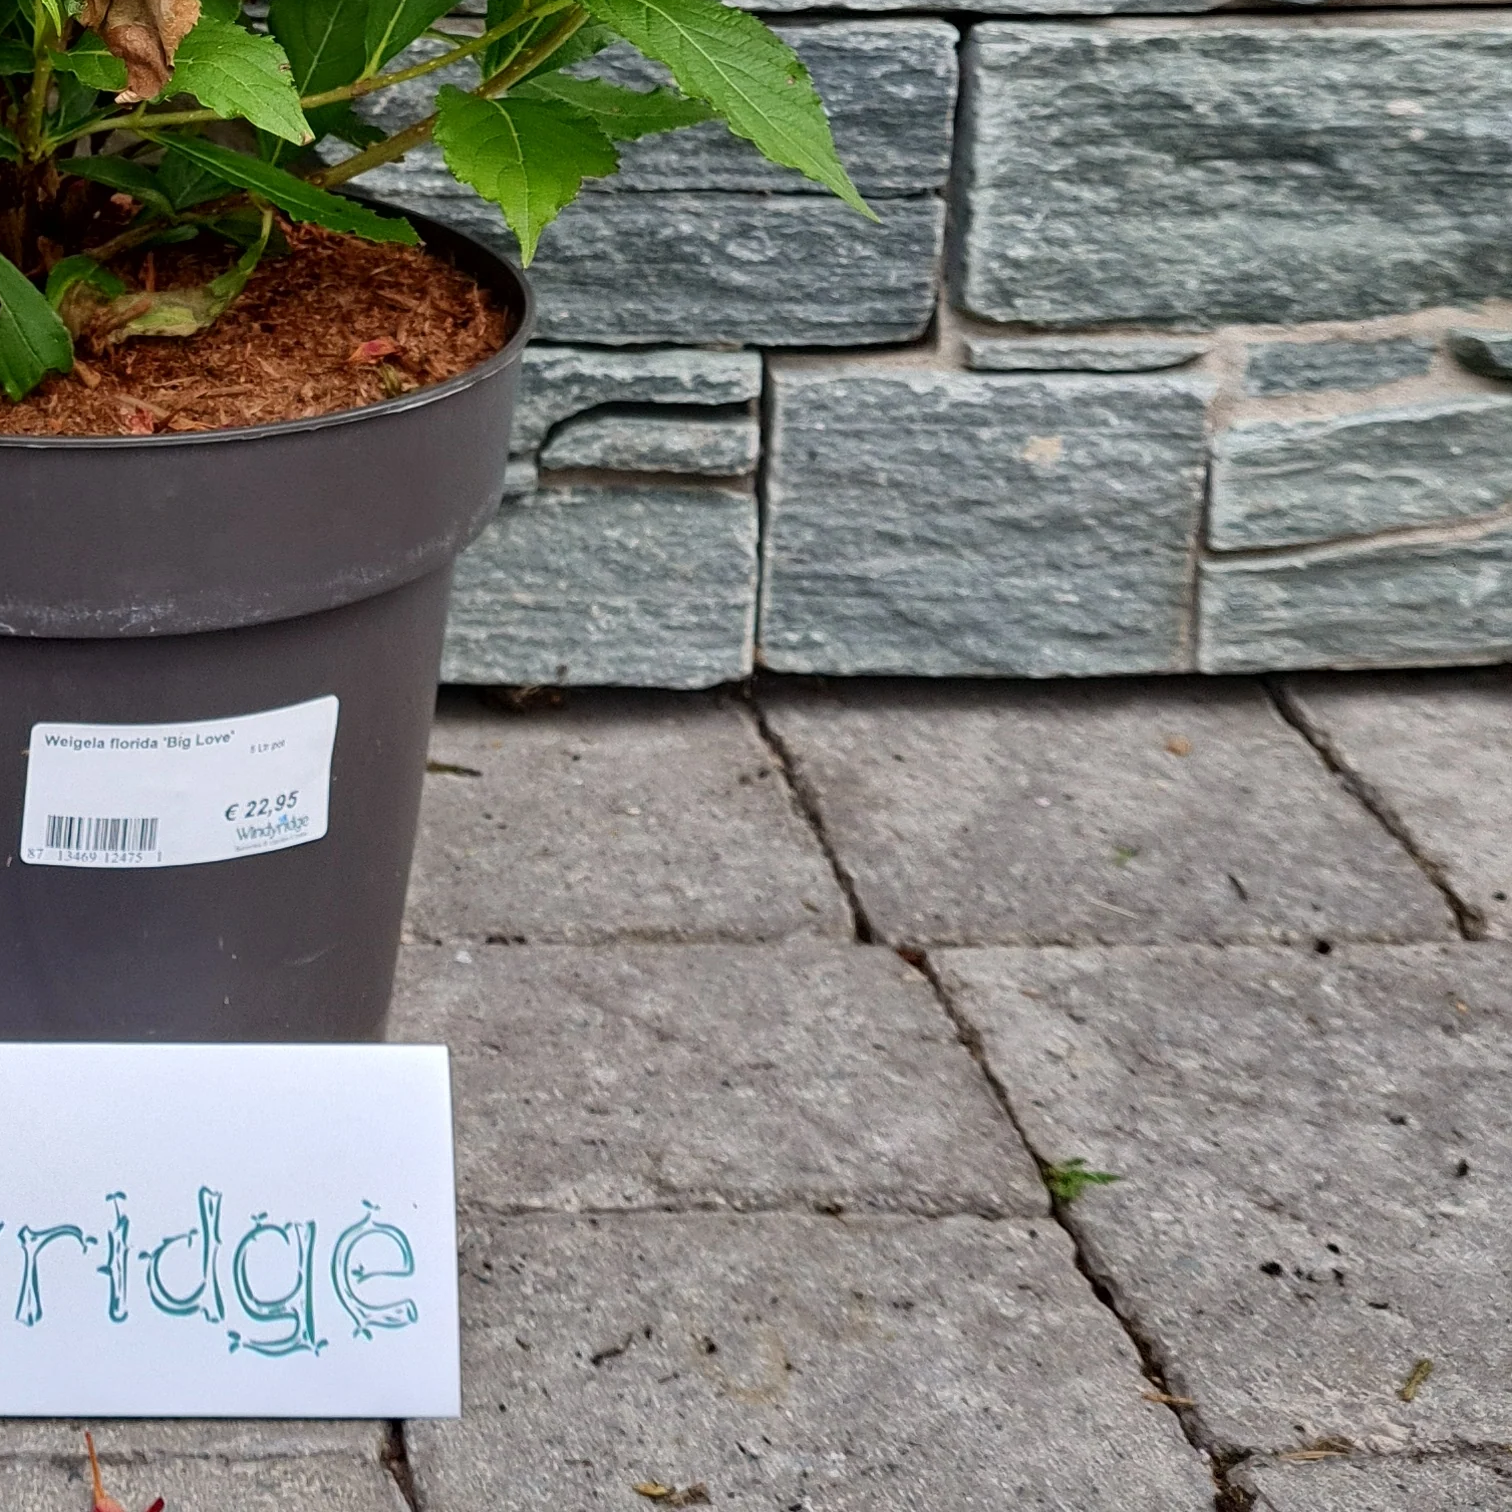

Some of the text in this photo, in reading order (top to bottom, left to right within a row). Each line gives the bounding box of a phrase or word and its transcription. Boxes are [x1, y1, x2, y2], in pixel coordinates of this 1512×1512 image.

[44, 733, 106, 752] Weigela
[109, 734, 159, 750] florida
[225, 790, 299, 821] € 22,95
[236, 815, 310, 841] Windyridge
[27, 848, 44, 860] 87
[57, 850, 98, 863] 13469
[103, 851, 144, 864] 12475
